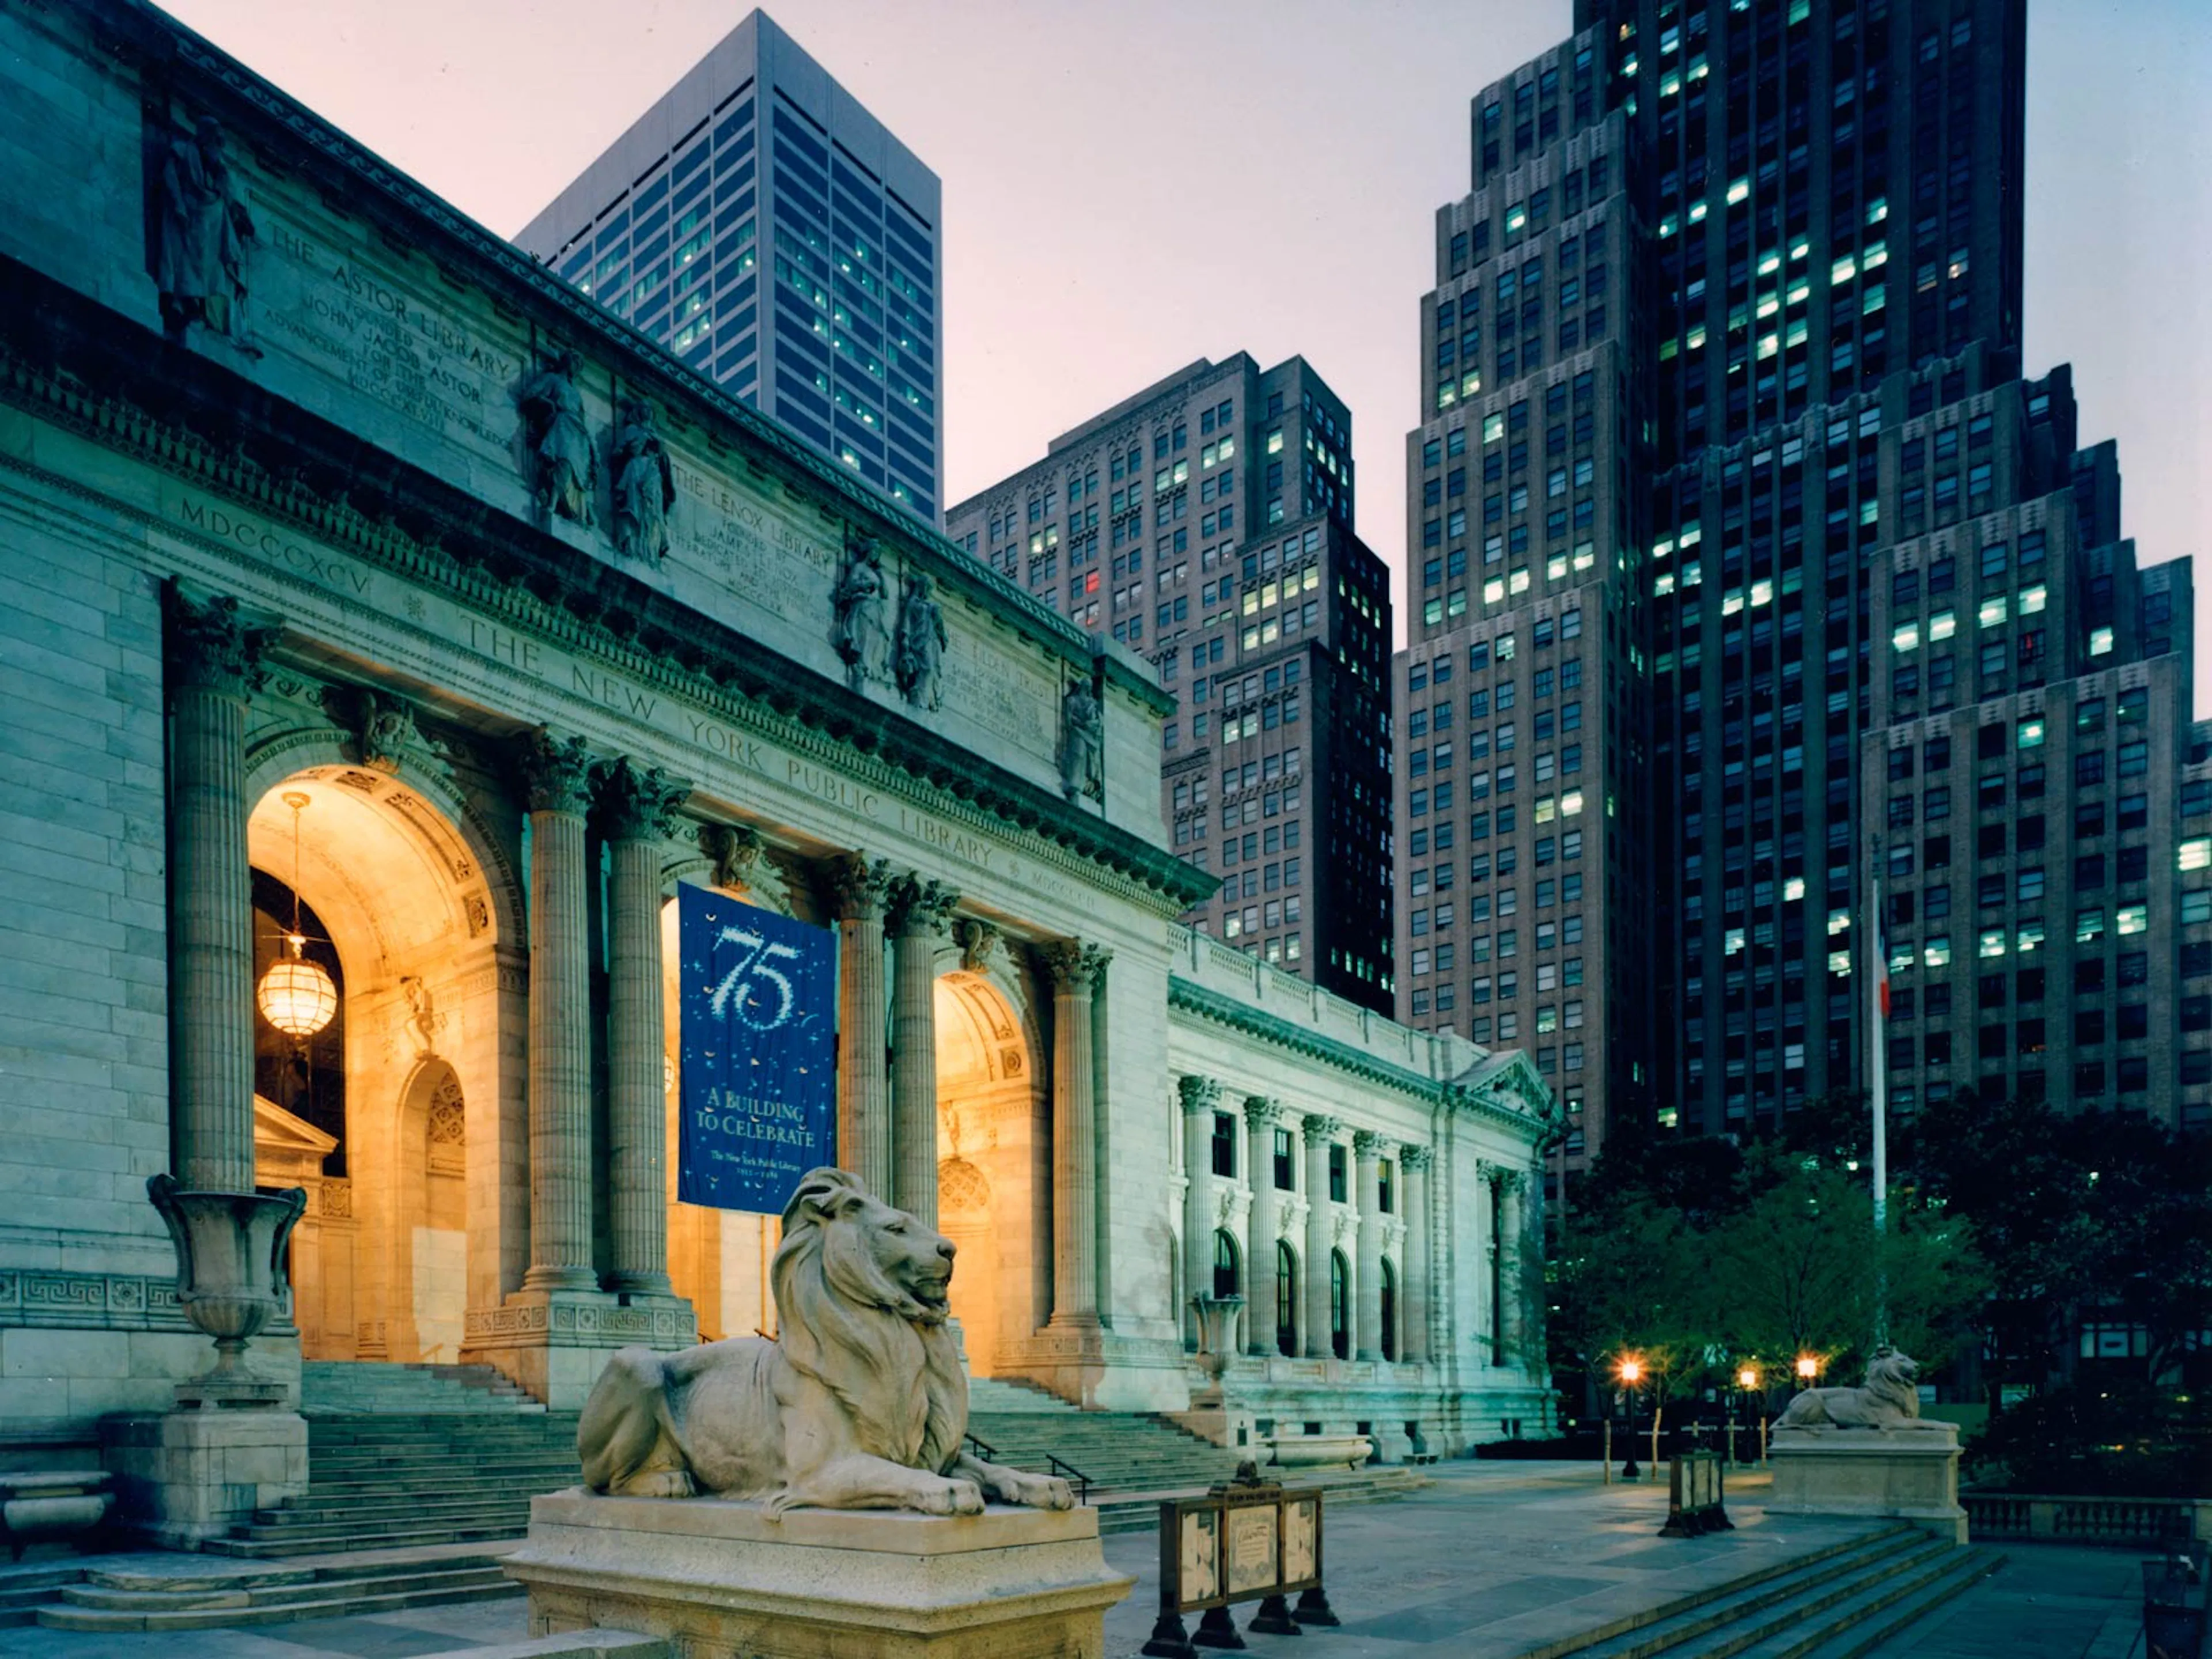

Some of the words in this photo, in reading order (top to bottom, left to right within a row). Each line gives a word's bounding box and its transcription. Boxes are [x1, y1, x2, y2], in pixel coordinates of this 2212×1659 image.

[268, 222, 315, 264] THE
[333, 266, 408, 324] ASTOR
[420, 313, 510, 379] LIBRARY
[346, 300, 412, 347] FOUNDED
[427, 347, 443, 365] BY
[264, 309, 368, 372] ADVANCEMENT
[373, 368, 389, 385] OF
[302, 294, 354, 333] JOHN
[363, 328, 420, 370] JACOB
[432, 365, 482, 404] ASTOR
[362, 344, 391, 369] FOR
[396, 363, 427, 392] THE
[181, 497, 368, 593] MDCCCXCV
[672, 463, 704, 498] THE
[711, 487, 764, 533] LENOX
[771, 524, 831, 571] LIBRARY
[462, 615, 543, 677] THE
[573, 664, 657, 720] NEW
[687, 715, 764, 771] YORK
[787, 759, 879, 819] PUBLIC
[901, 809, 993, 866] LIBRARY
[711, 925, 802, 1030] 75
[695, 1109, 719, 1131] TO
[722, 1115, 816, 1148] CELEBRATE
[707, 1087, 720, 1107] A
[725, 1090, 804, 1123] BUILDING
[710, 1149, 724, 1161] The
[778, 1161, 801, 1174] Library
